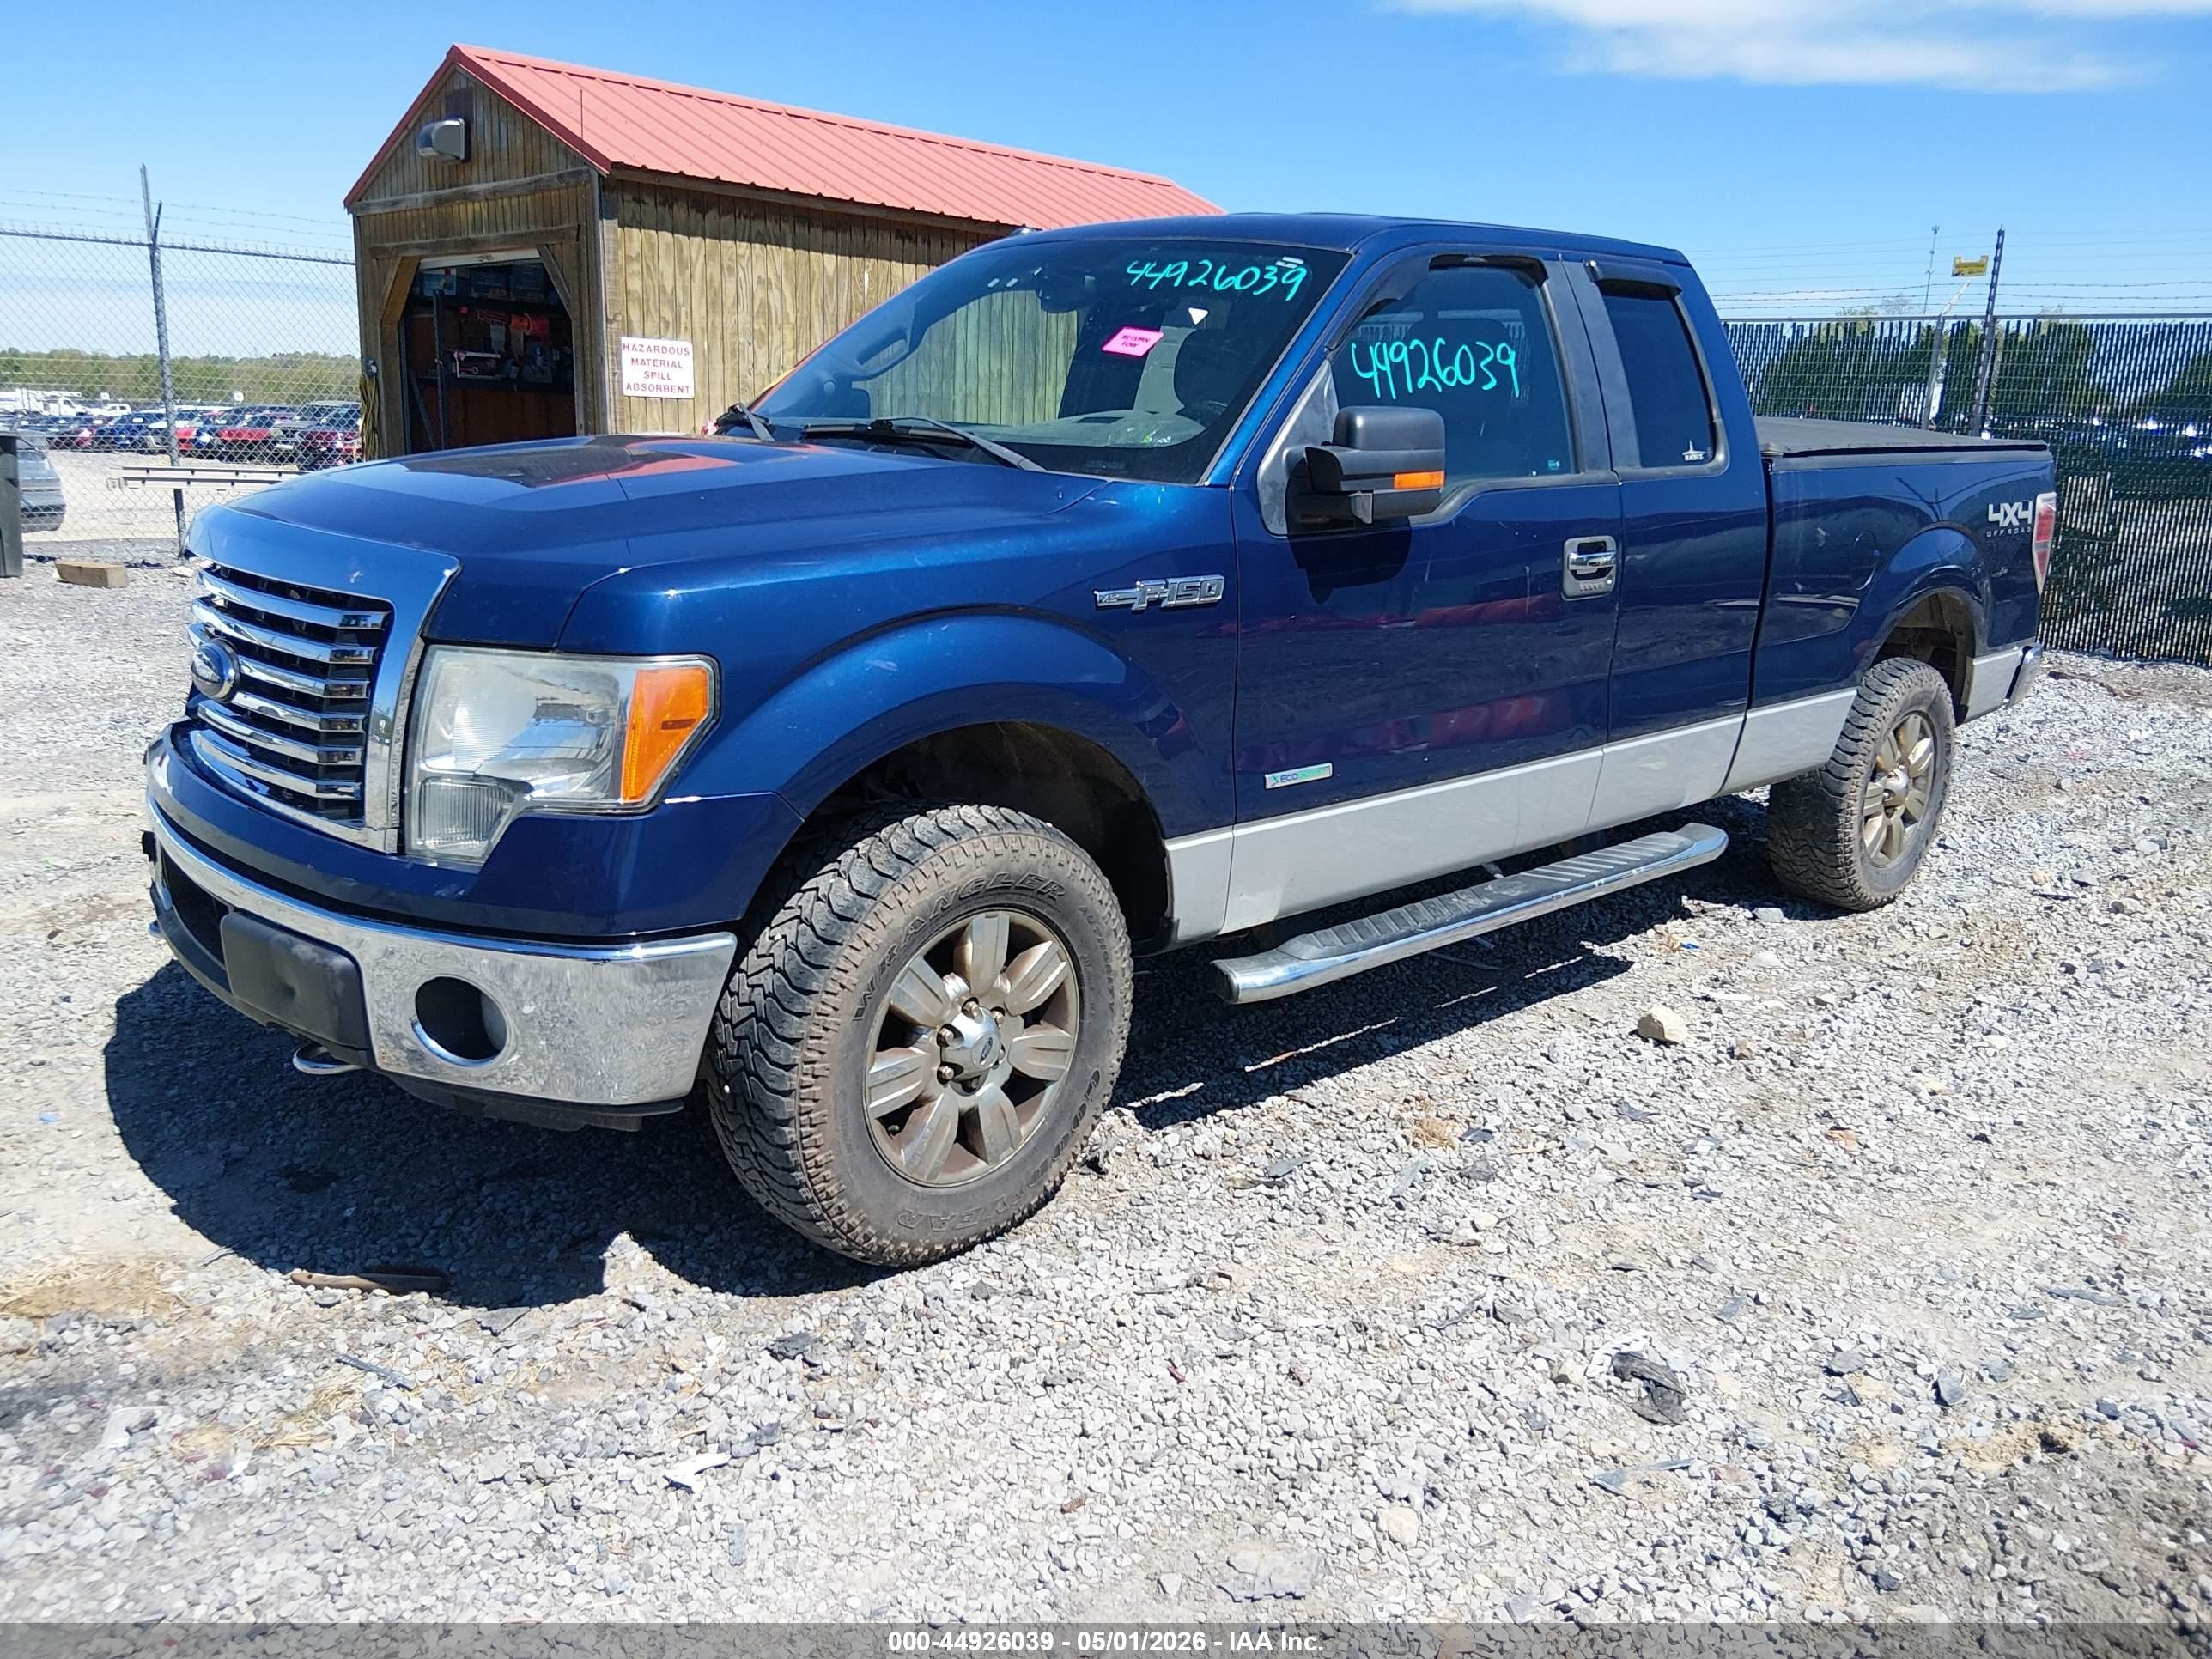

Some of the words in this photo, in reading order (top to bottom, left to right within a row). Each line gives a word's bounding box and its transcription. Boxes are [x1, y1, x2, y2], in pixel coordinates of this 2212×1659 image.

[1127, 260, 1307, 301] 44926039
[623, 343, 690, 356] HAZARDOUS
[631, 357, 683, 369] MATERIAL
[1352, 338, 1519, 399] 44926039
[644, 371, 673, 380] SPILL
[626, 382, 690, 394] ABSORBENT
[852, 871, 1066, 1022] WRANGLER
